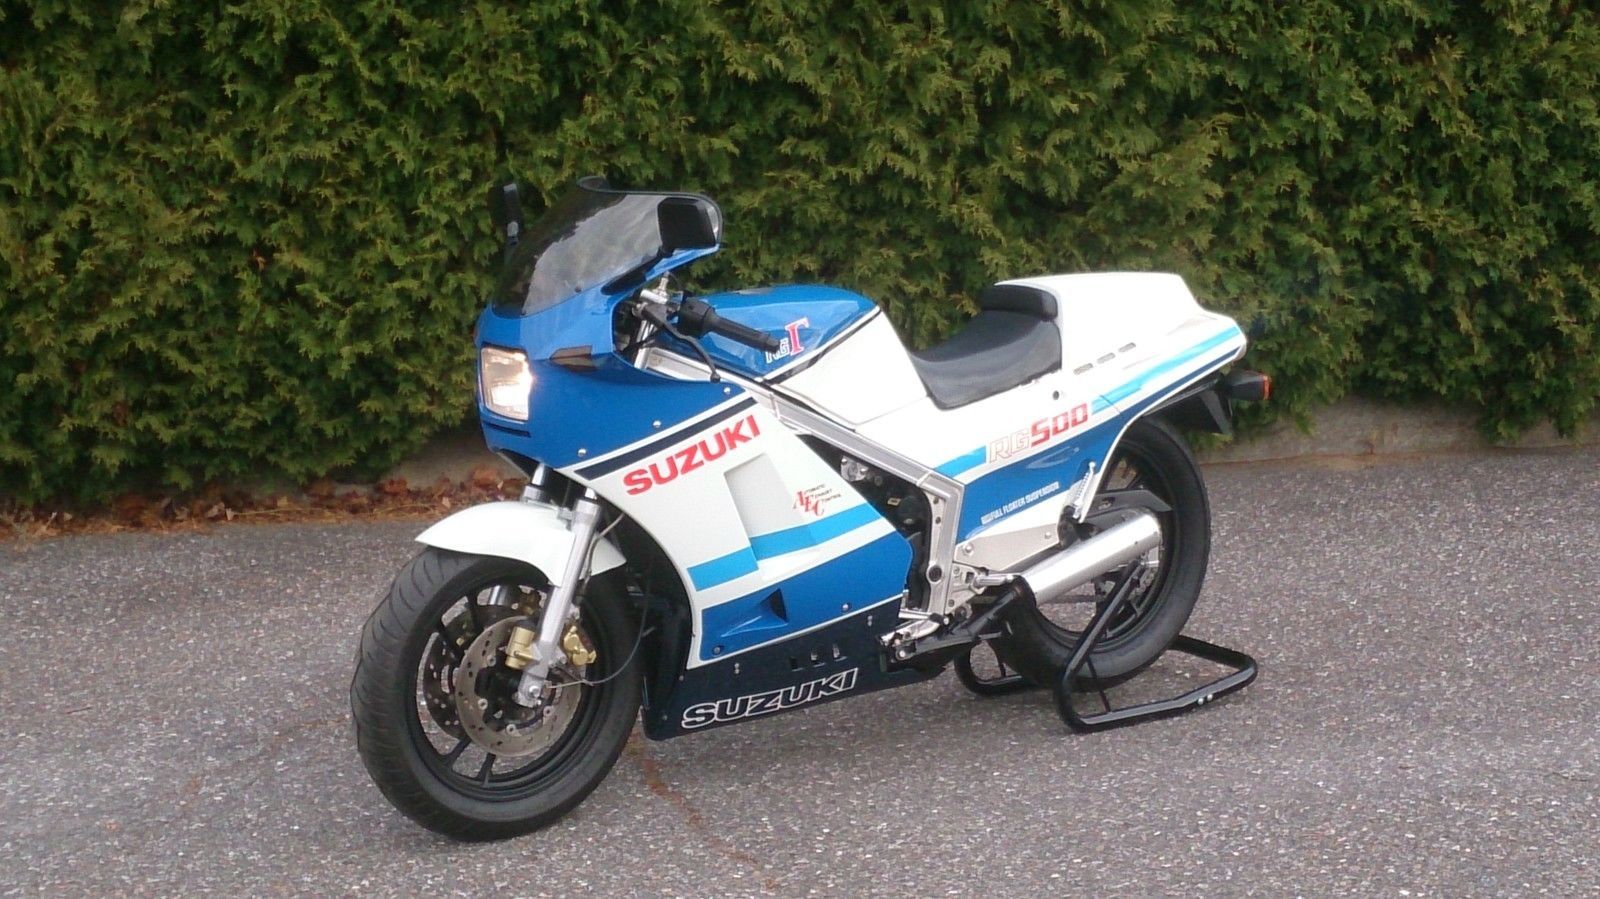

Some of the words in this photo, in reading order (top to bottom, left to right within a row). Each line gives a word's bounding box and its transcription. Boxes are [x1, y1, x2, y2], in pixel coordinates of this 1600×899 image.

[623, 414, 761, 496] SUZUKI
[989, 403, 1088, 464] RG500
[681, 667, 859, 729] SUZUKI
